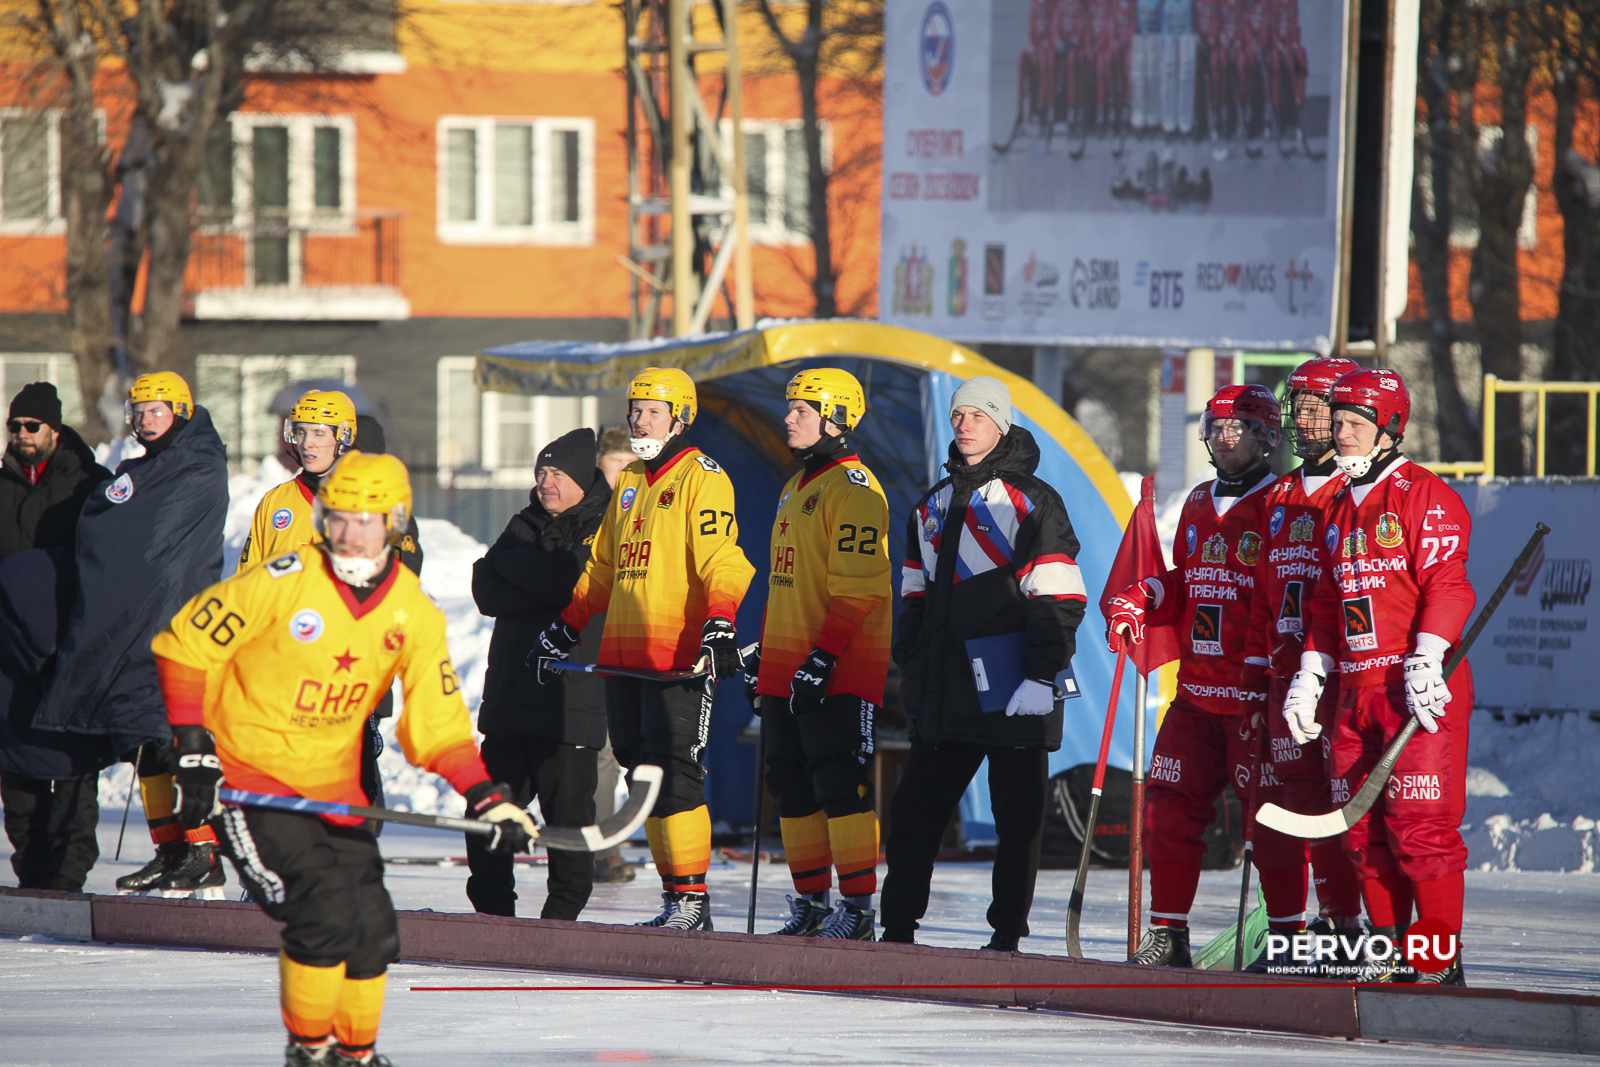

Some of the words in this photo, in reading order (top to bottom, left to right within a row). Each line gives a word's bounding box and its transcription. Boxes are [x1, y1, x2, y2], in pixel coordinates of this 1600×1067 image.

[1089, 258, 1119, 283] SIMA
[1088, 285, 1121, 309] LAND
[1150, 270, 1185, 310] ВТБ
[1394, 478, 1413, 492] ВТБ
[699, 509, 734, 536] 27
[1437, 523, 1460, 532] group
[837, 523, 879, 556] 22
[1421, 535, 1460, 570] 27
[1540, 558, 1592, 612] ДИНУР
[1108, 597, 1145, 616] CCM
[191, 597, 245, 647] 66
[539, 630, 570, 659] CCM
[1194, 641, 1221, 653] ПНТЗ
[1347, 635, 1375, 649] ПНТЗ
[1153, 754, 1182, 772] SIMA
[1273, 748, 1303, 763] LAND
[1151, 766, 1182, 783] LAND
[1402, 775, 1441, 788] SIMA
[1402, 787, 1441, 800] LAND
